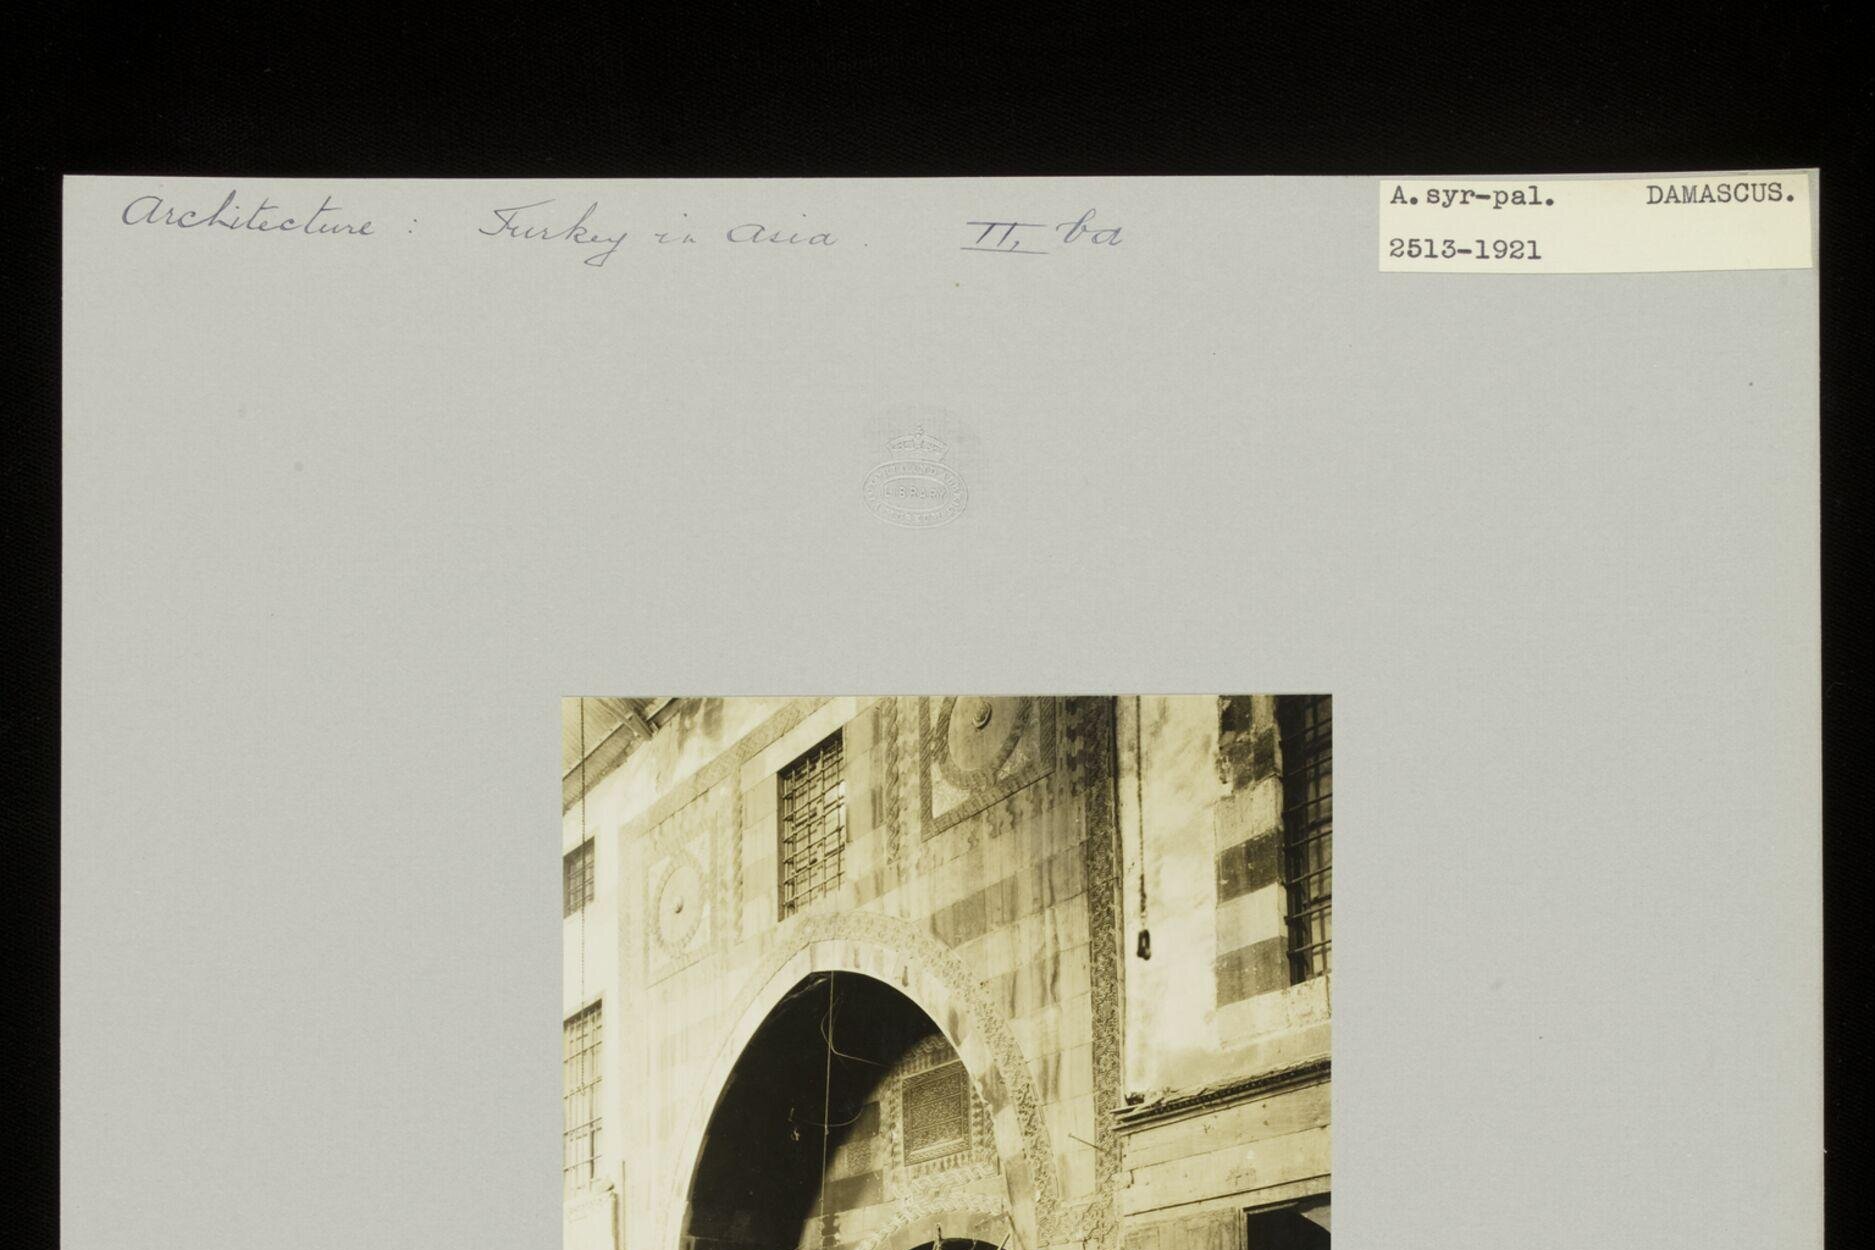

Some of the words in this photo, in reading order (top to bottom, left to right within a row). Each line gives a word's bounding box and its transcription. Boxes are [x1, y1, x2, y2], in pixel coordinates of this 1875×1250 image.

[1646, 182, 1796, 205] DAMASCUS.
[478, 199, 628, 268] Turkey
[655, 213, 697, 244] in
[1389, 238, 1543, 261] 2513-1921
